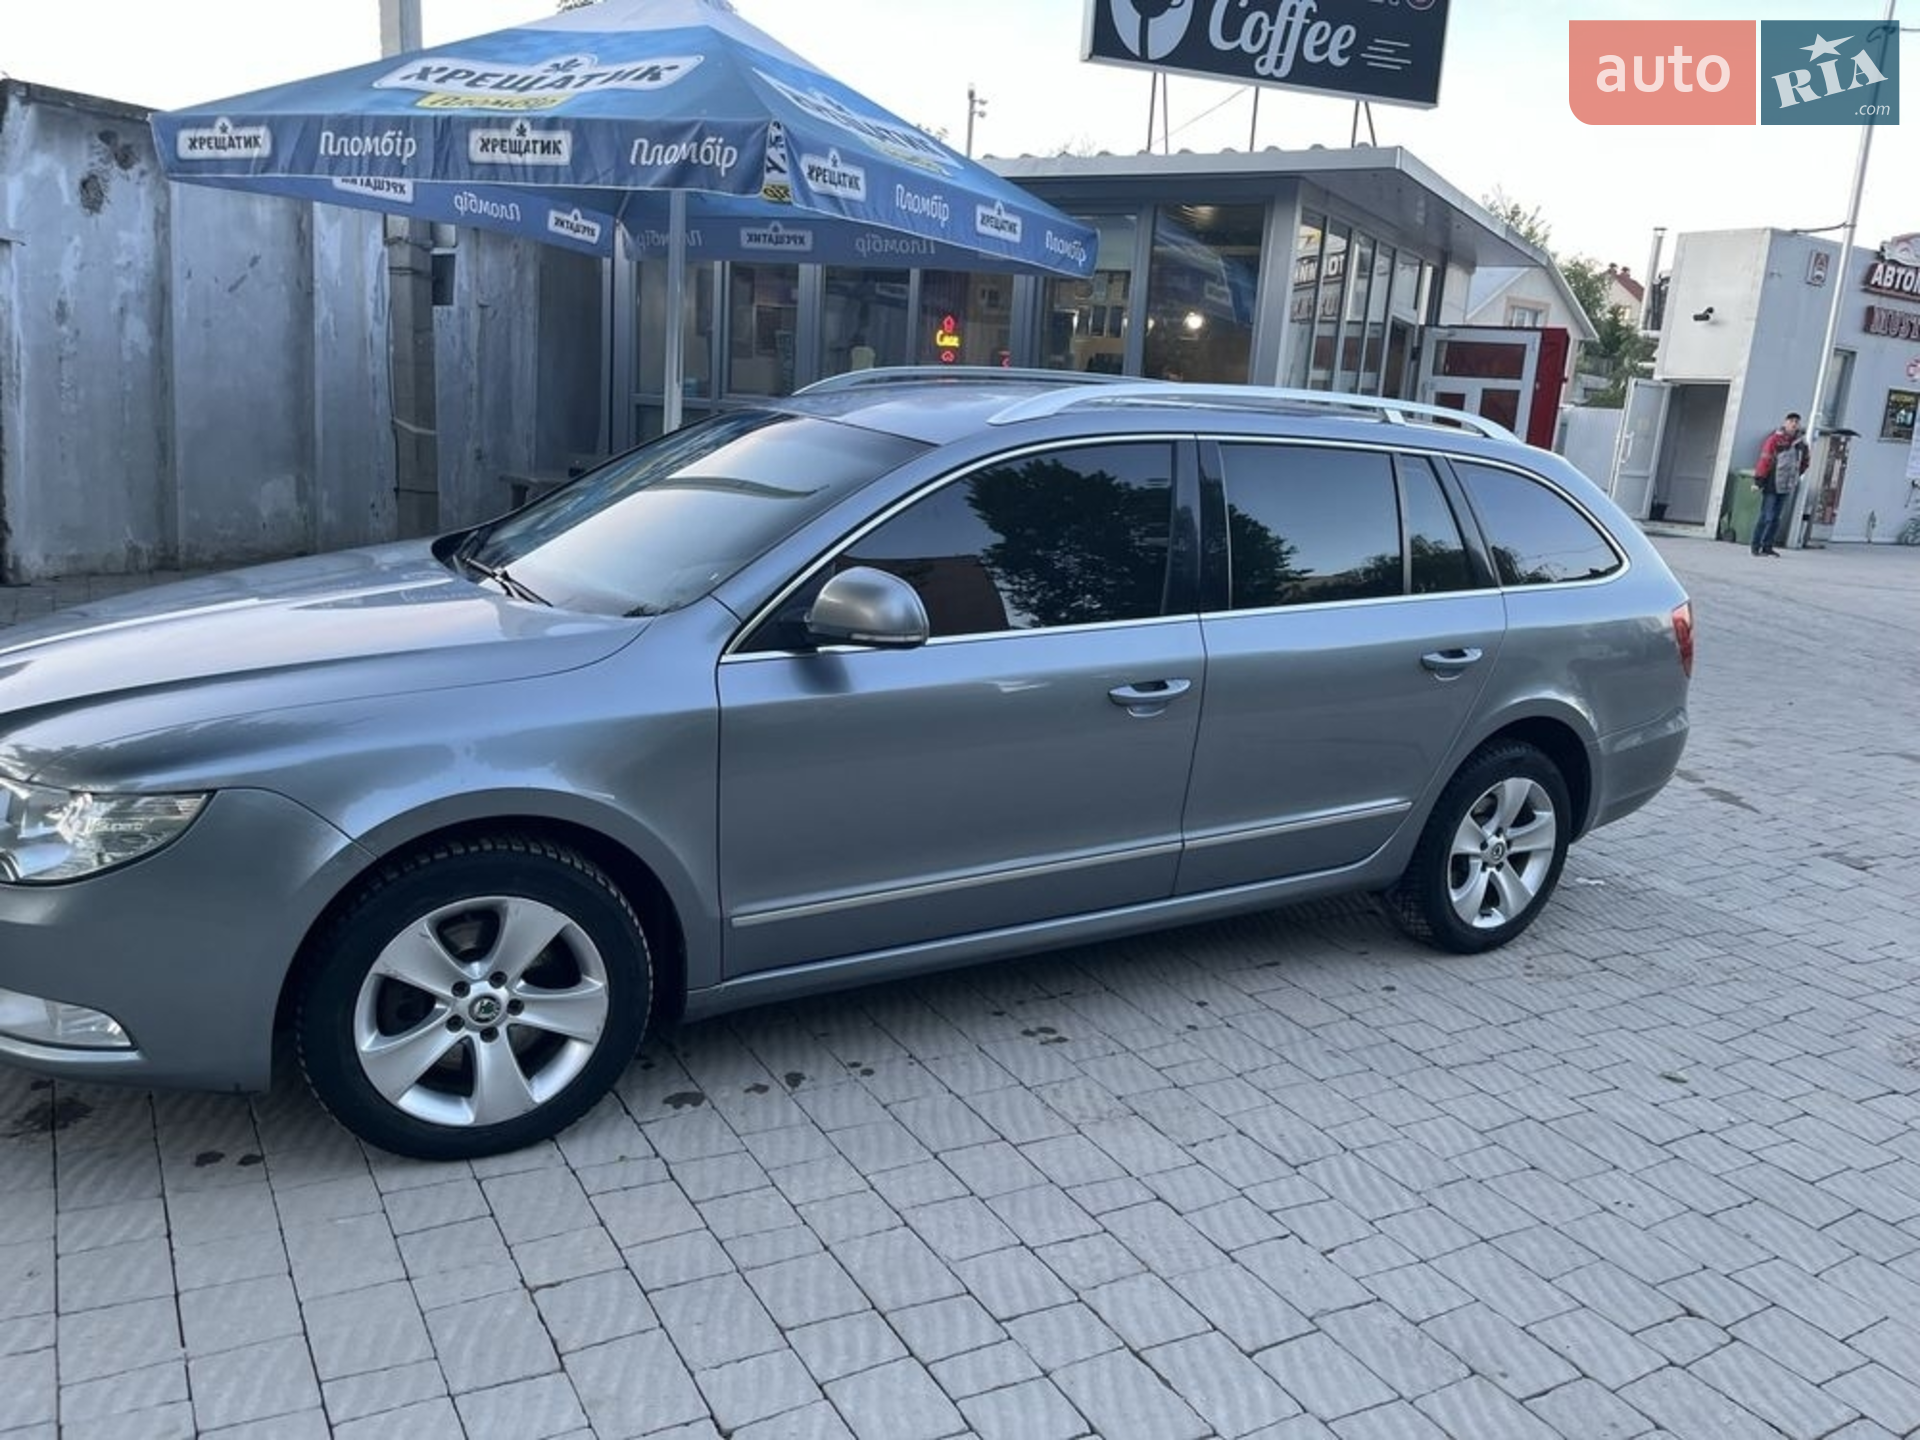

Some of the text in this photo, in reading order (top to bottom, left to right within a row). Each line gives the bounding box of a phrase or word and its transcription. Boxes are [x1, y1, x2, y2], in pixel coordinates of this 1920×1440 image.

[1209, 0, 1357, 78] Coffee
[403, 64, 679, 93] ХРЕЩАТИК
[188, 134, 262, 152] ХРЕЩАТИК
[320, 131, 416, 165] Пломбір
[479, 136, 562, 157] ХРЕЩАТИК
[629, 137, 738, 176] Пломбір
[807, 163, 861, 191] ХРЕЩАТИК
[896, 184, 950, 227] Пломбір
[980, 212, 1019, 235] ХРЕЩАТИК
[1045, 230, 1087, 267] Пломбір
